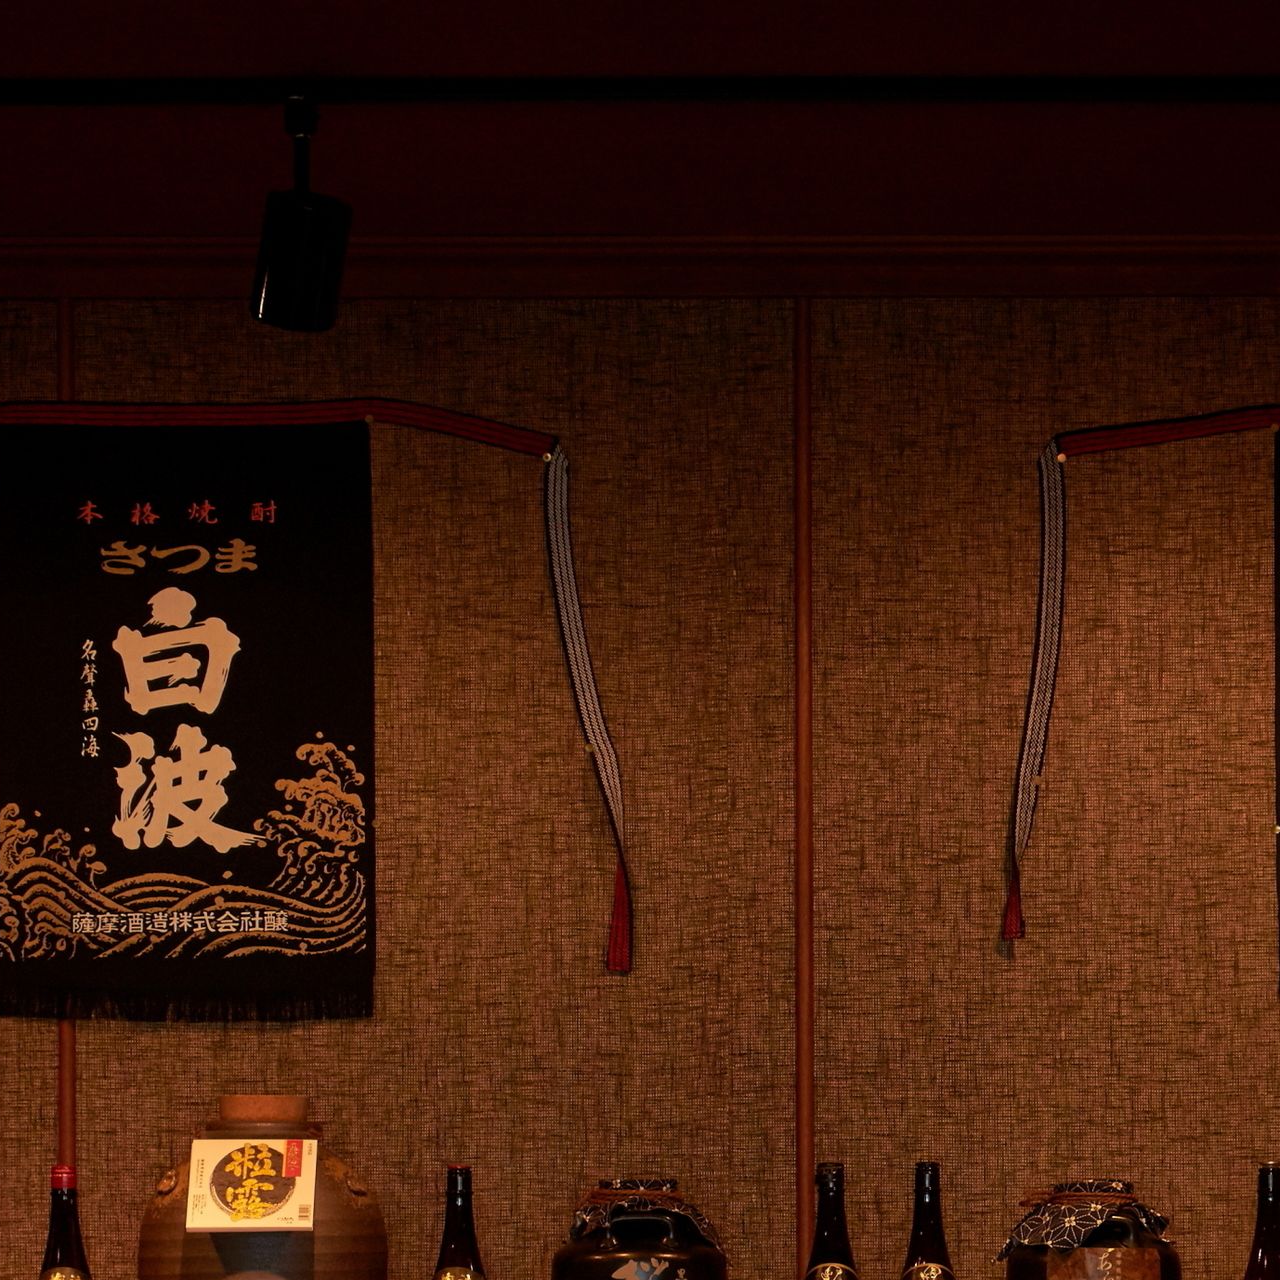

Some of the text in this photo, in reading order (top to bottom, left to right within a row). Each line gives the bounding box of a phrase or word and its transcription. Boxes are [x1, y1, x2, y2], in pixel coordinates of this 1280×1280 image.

[77, 500, 277, 524] 本格焼酎
[100, 538, 258, 575] さつま
[112, 587, 268, 853] 白波
